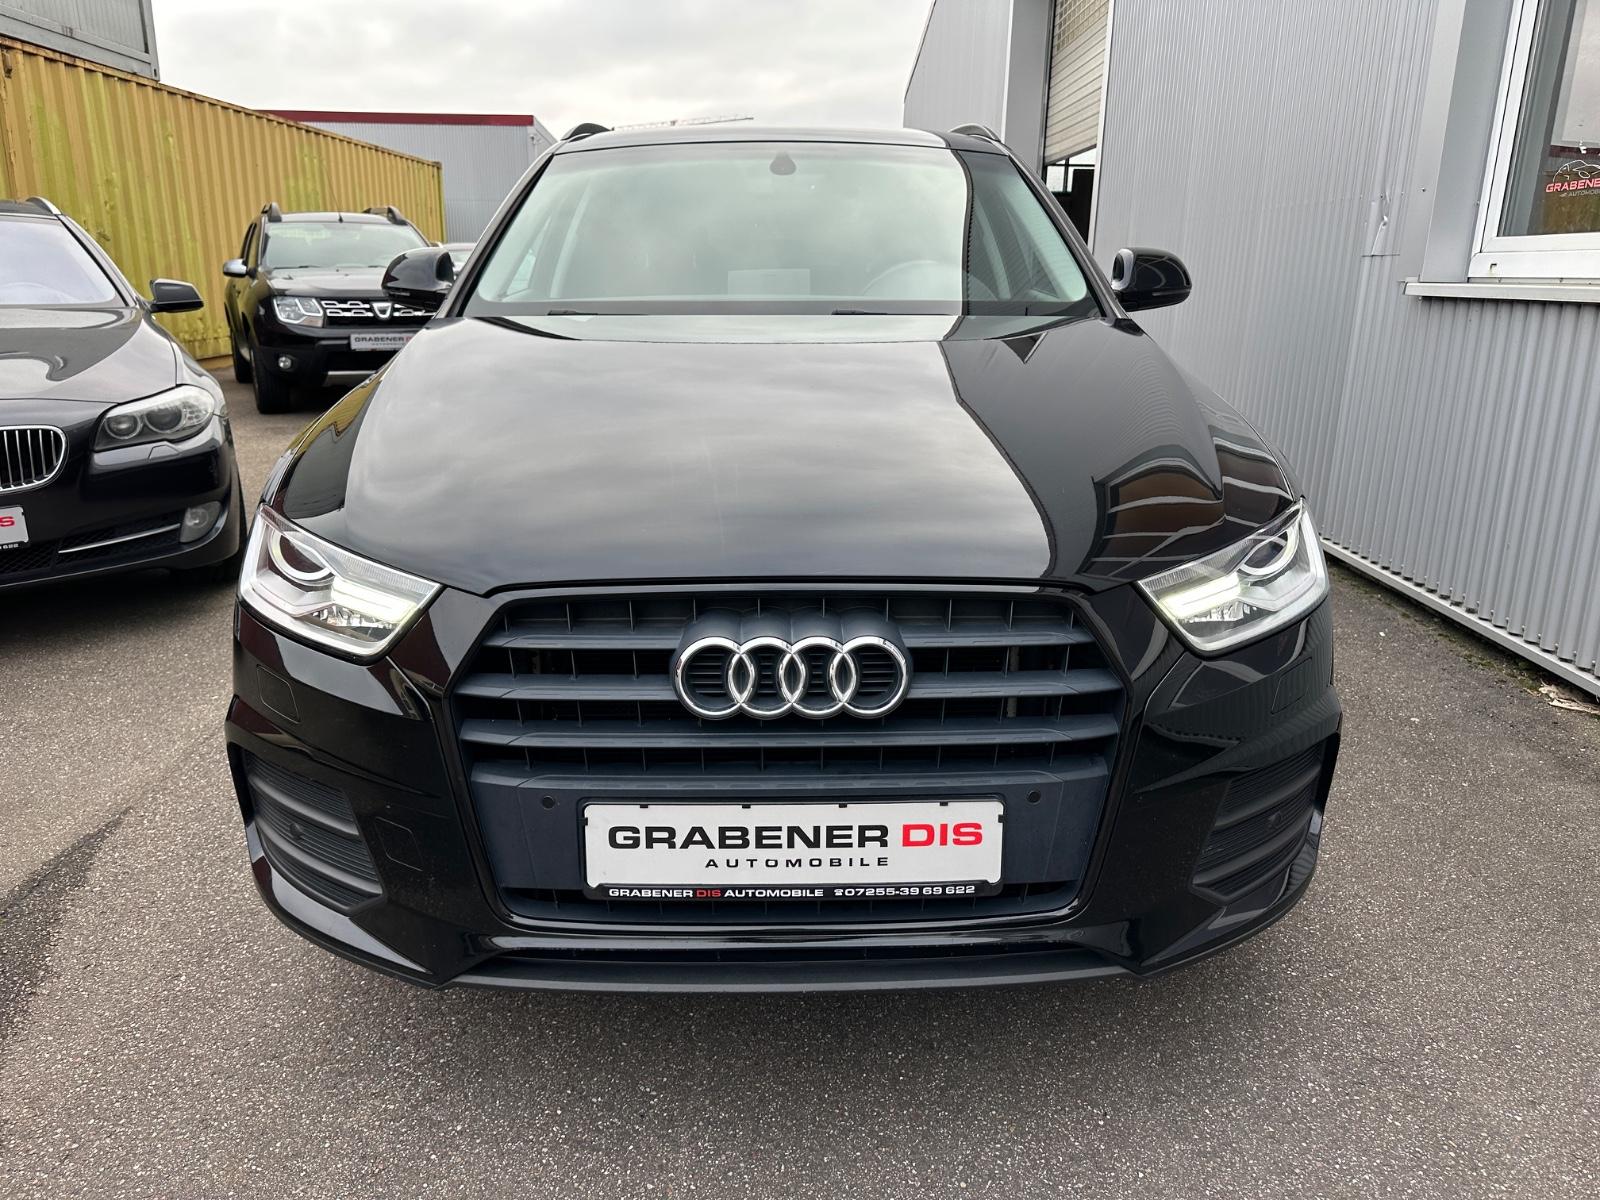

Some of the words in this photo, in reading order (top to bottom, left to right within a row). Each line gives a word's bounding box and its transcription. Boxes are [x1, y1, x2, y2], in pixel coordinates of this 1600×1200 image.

[608, 824, 889, 850] GRABENER
[902, 822, 983, 847] DIS
[705, 856, 889, 869] AUTOMOBILE
[608, 888, 694, 898] GRABENER
[696, 889, 721, 898] DIS
[724, 888, 824, 898] AUTOMOBILE
[946, 885, 975, 895] 622
